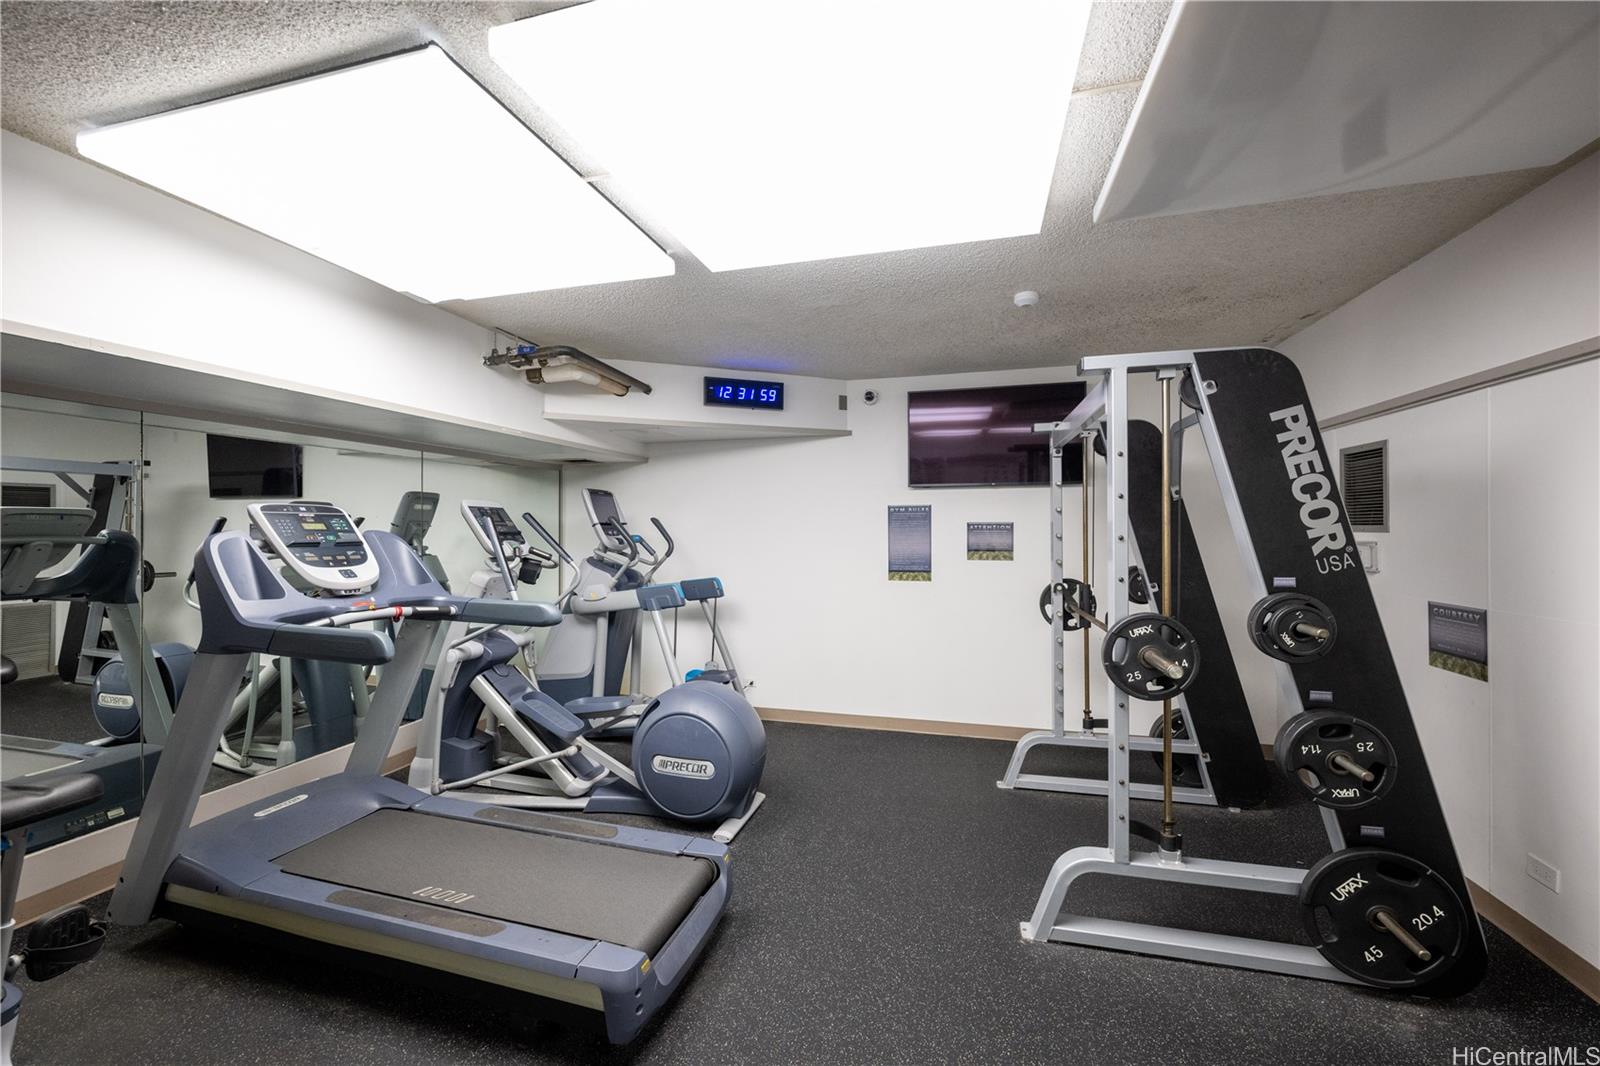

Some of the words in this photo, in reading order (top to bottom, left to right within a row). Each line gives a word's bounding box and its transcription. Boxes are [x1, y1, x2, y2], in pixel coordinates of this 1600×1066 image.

[719, 386, 732, 399] 12
[738, 387, 755, 400] 31
[760, 389, 777, 402] 59
[1269, 403, 1347, 557] PRECOR
[1315, 553, 1356, 575] USA
[1433, 607, 1480, 621] COURTESY
[1126, 670, 1142, 682] 25
[1301, 744, 1322, 755] 11.4
[1356, 741, 1375, 753] 25
[663, 760, 709, 775] PRECOR
[1330, 872, 1369, 902] UMAX
[1412, 904, 1445, 931] 20.4
[1363, 944, 1384, 963] 45
